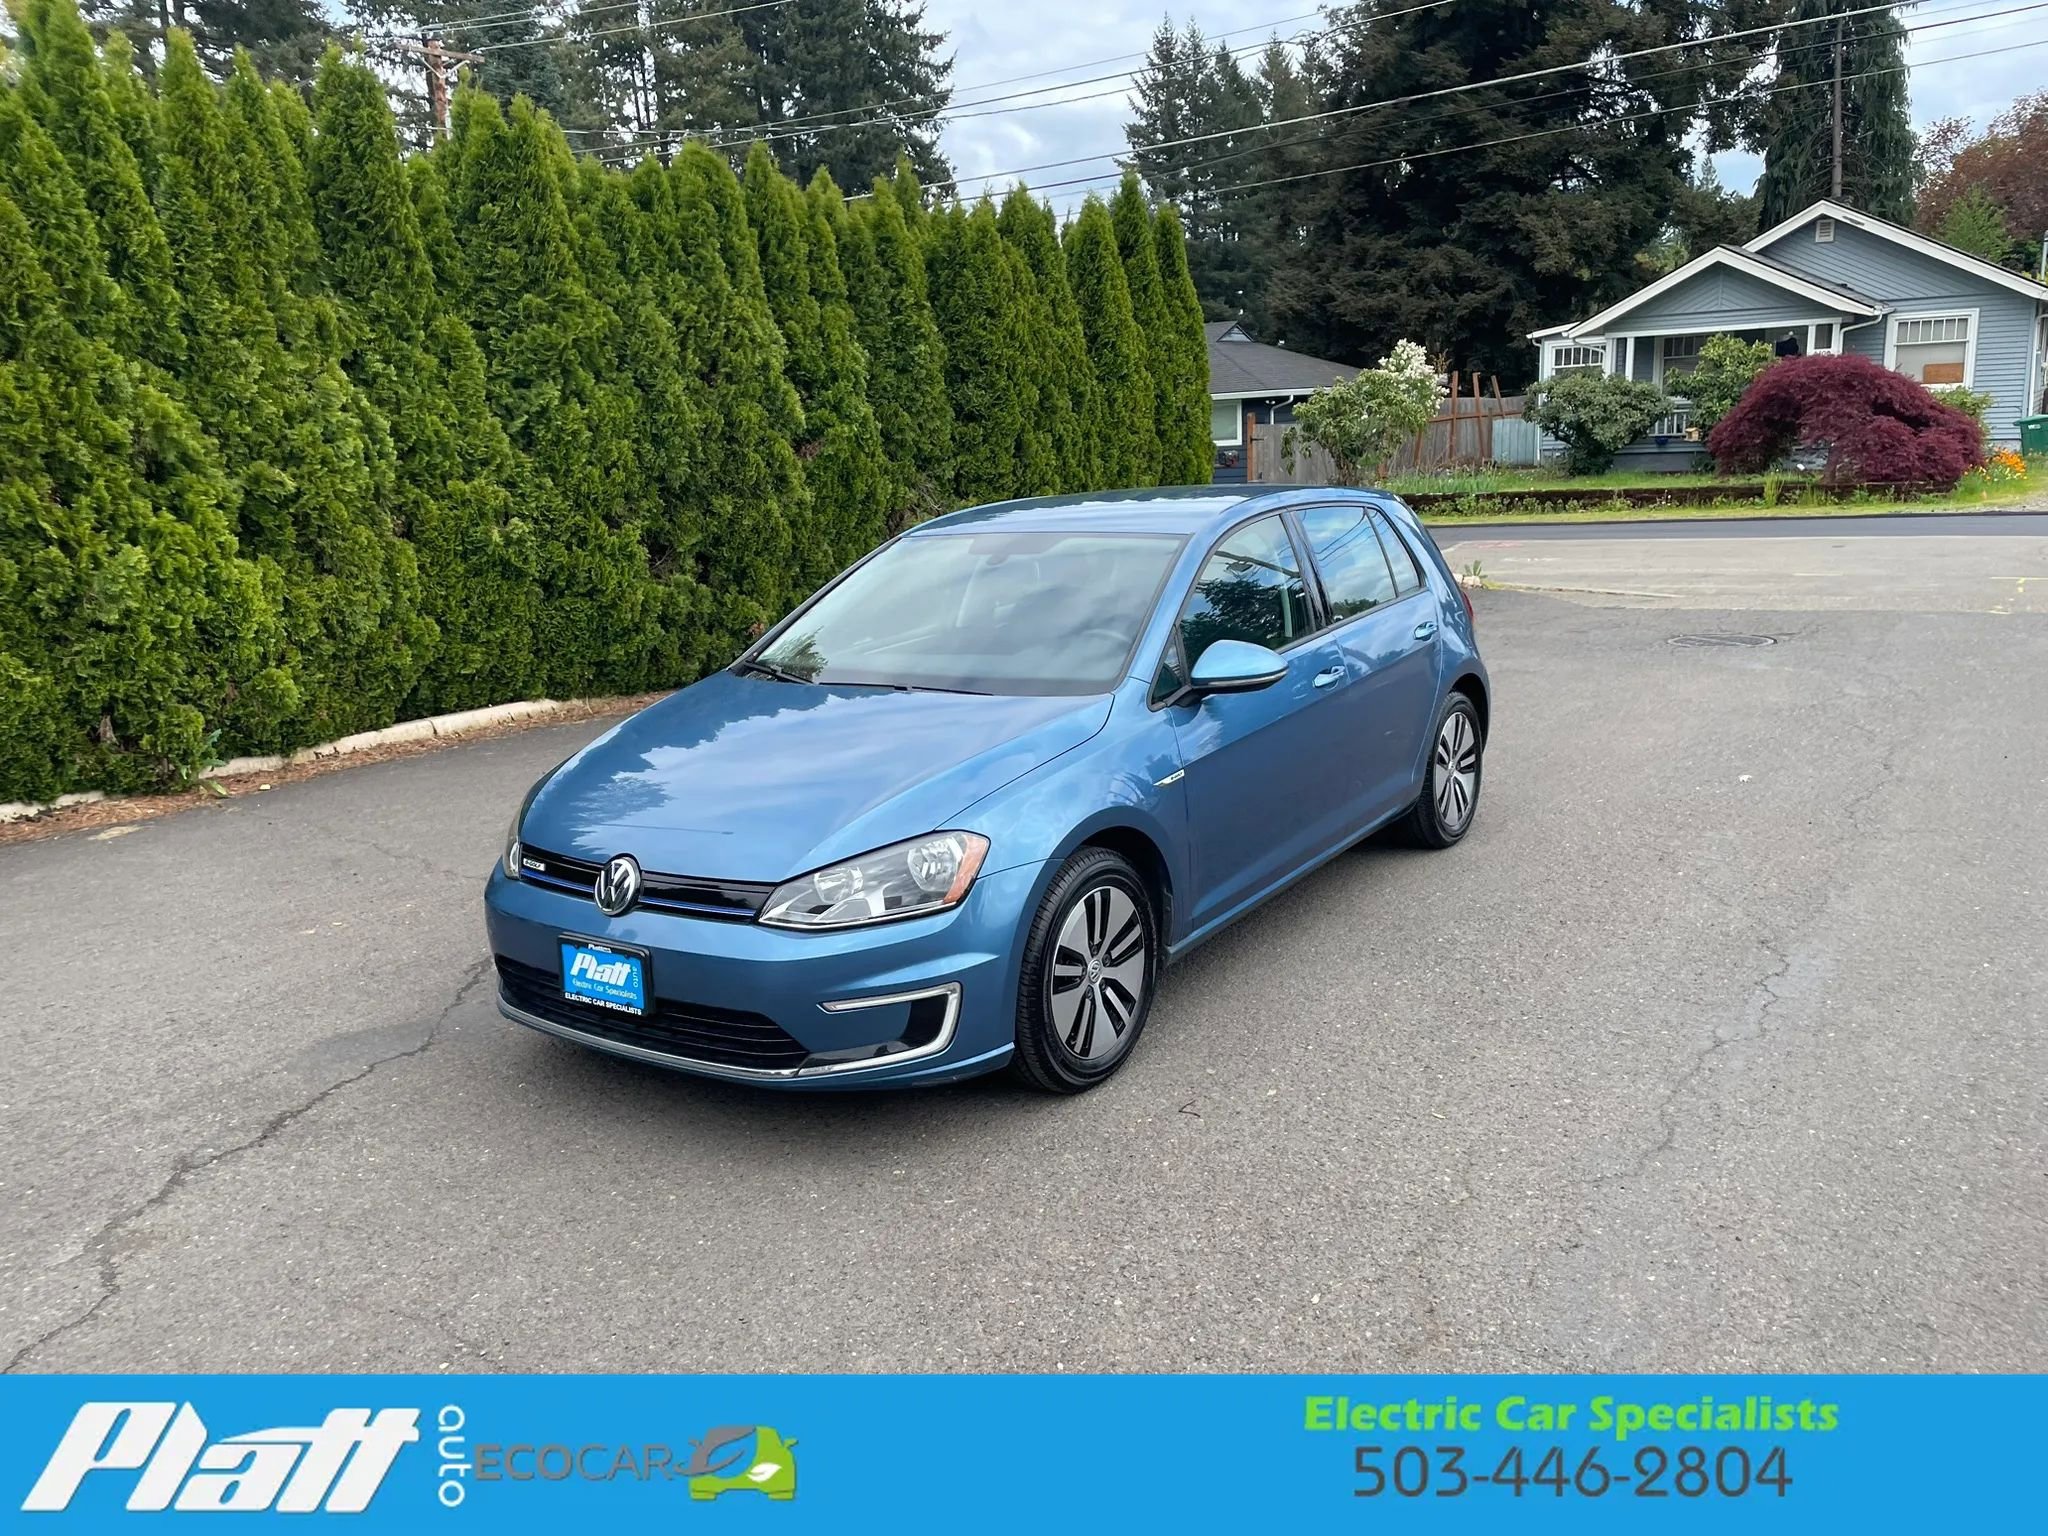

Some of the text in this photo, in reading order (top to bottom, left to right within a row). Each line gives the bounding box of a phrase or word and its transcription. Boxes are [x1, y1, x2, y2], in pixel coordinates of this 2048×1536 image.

[570, 953, 631, 987] Platt
[564, 992, 642, 1016] ELECTRIC CAR SPECIALISTS
